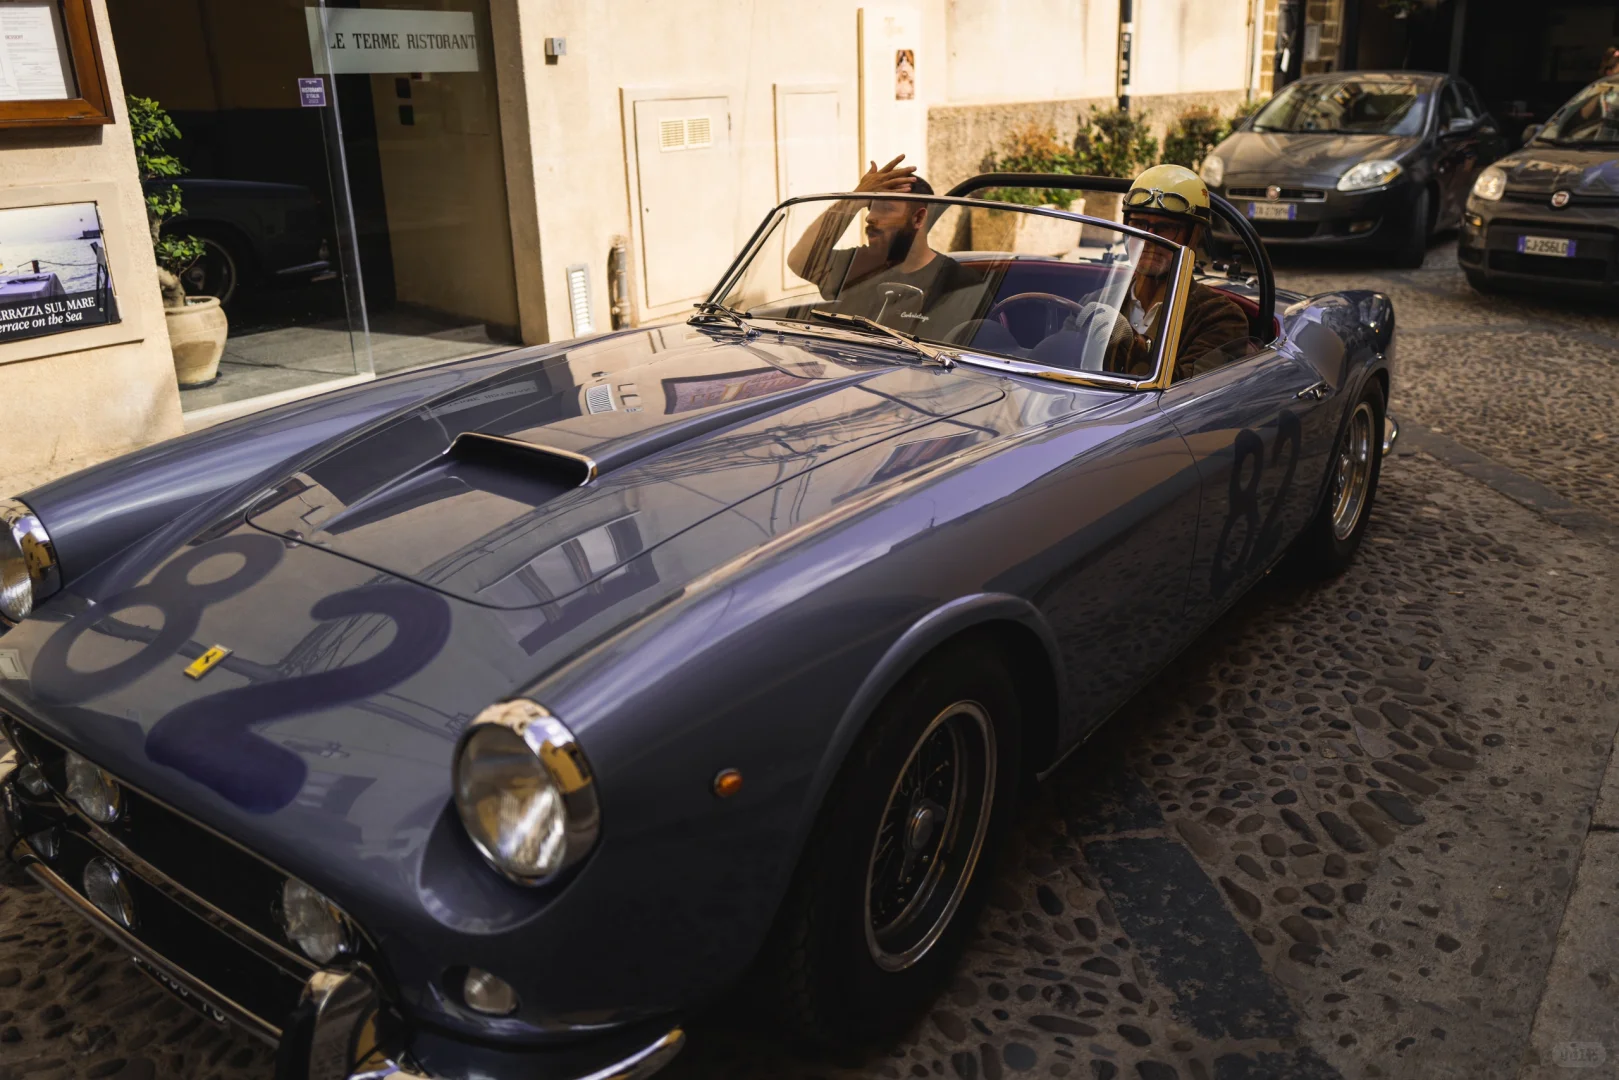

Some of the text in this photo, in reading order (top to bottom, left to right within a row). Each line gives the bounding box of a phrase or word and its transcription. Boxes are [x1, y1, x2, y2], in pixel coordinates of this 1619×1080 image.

[352, 33, 401, 49] TERME
[406, 33, 476, 50] RISTORANT
[0, 297, 95, 321] RRAZZA SUL MARE
[32, 318, 46, 328] on
[48, 313, 64, 325] the
[65, 311, 83, 323] Sea
